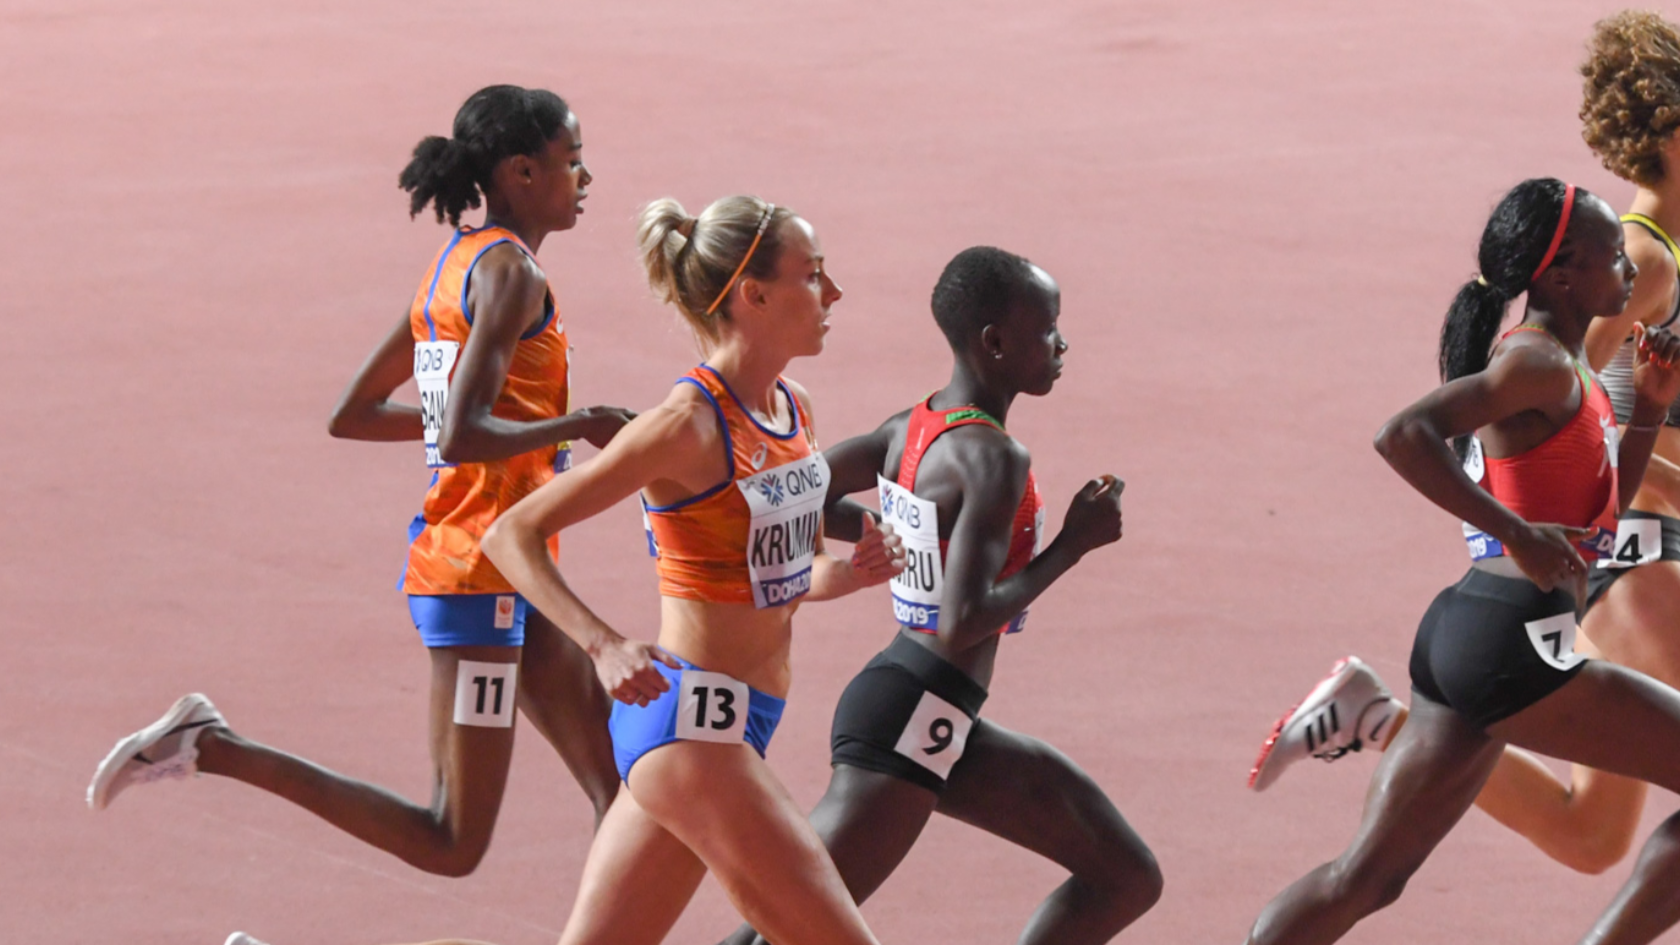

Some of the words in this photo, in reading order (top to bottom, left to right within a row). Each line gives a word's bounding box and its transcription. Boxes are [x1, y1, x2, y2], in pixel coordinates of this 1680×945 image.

[786, 464, 822, 496] QNB
[1616, 533, 1643, 564] 4
[1541, 630, 1565, 663] 7
[472, 676, 504, 715] 11
[692, 686, 735, 730] 13
[921, 717, 954, 755] 9
